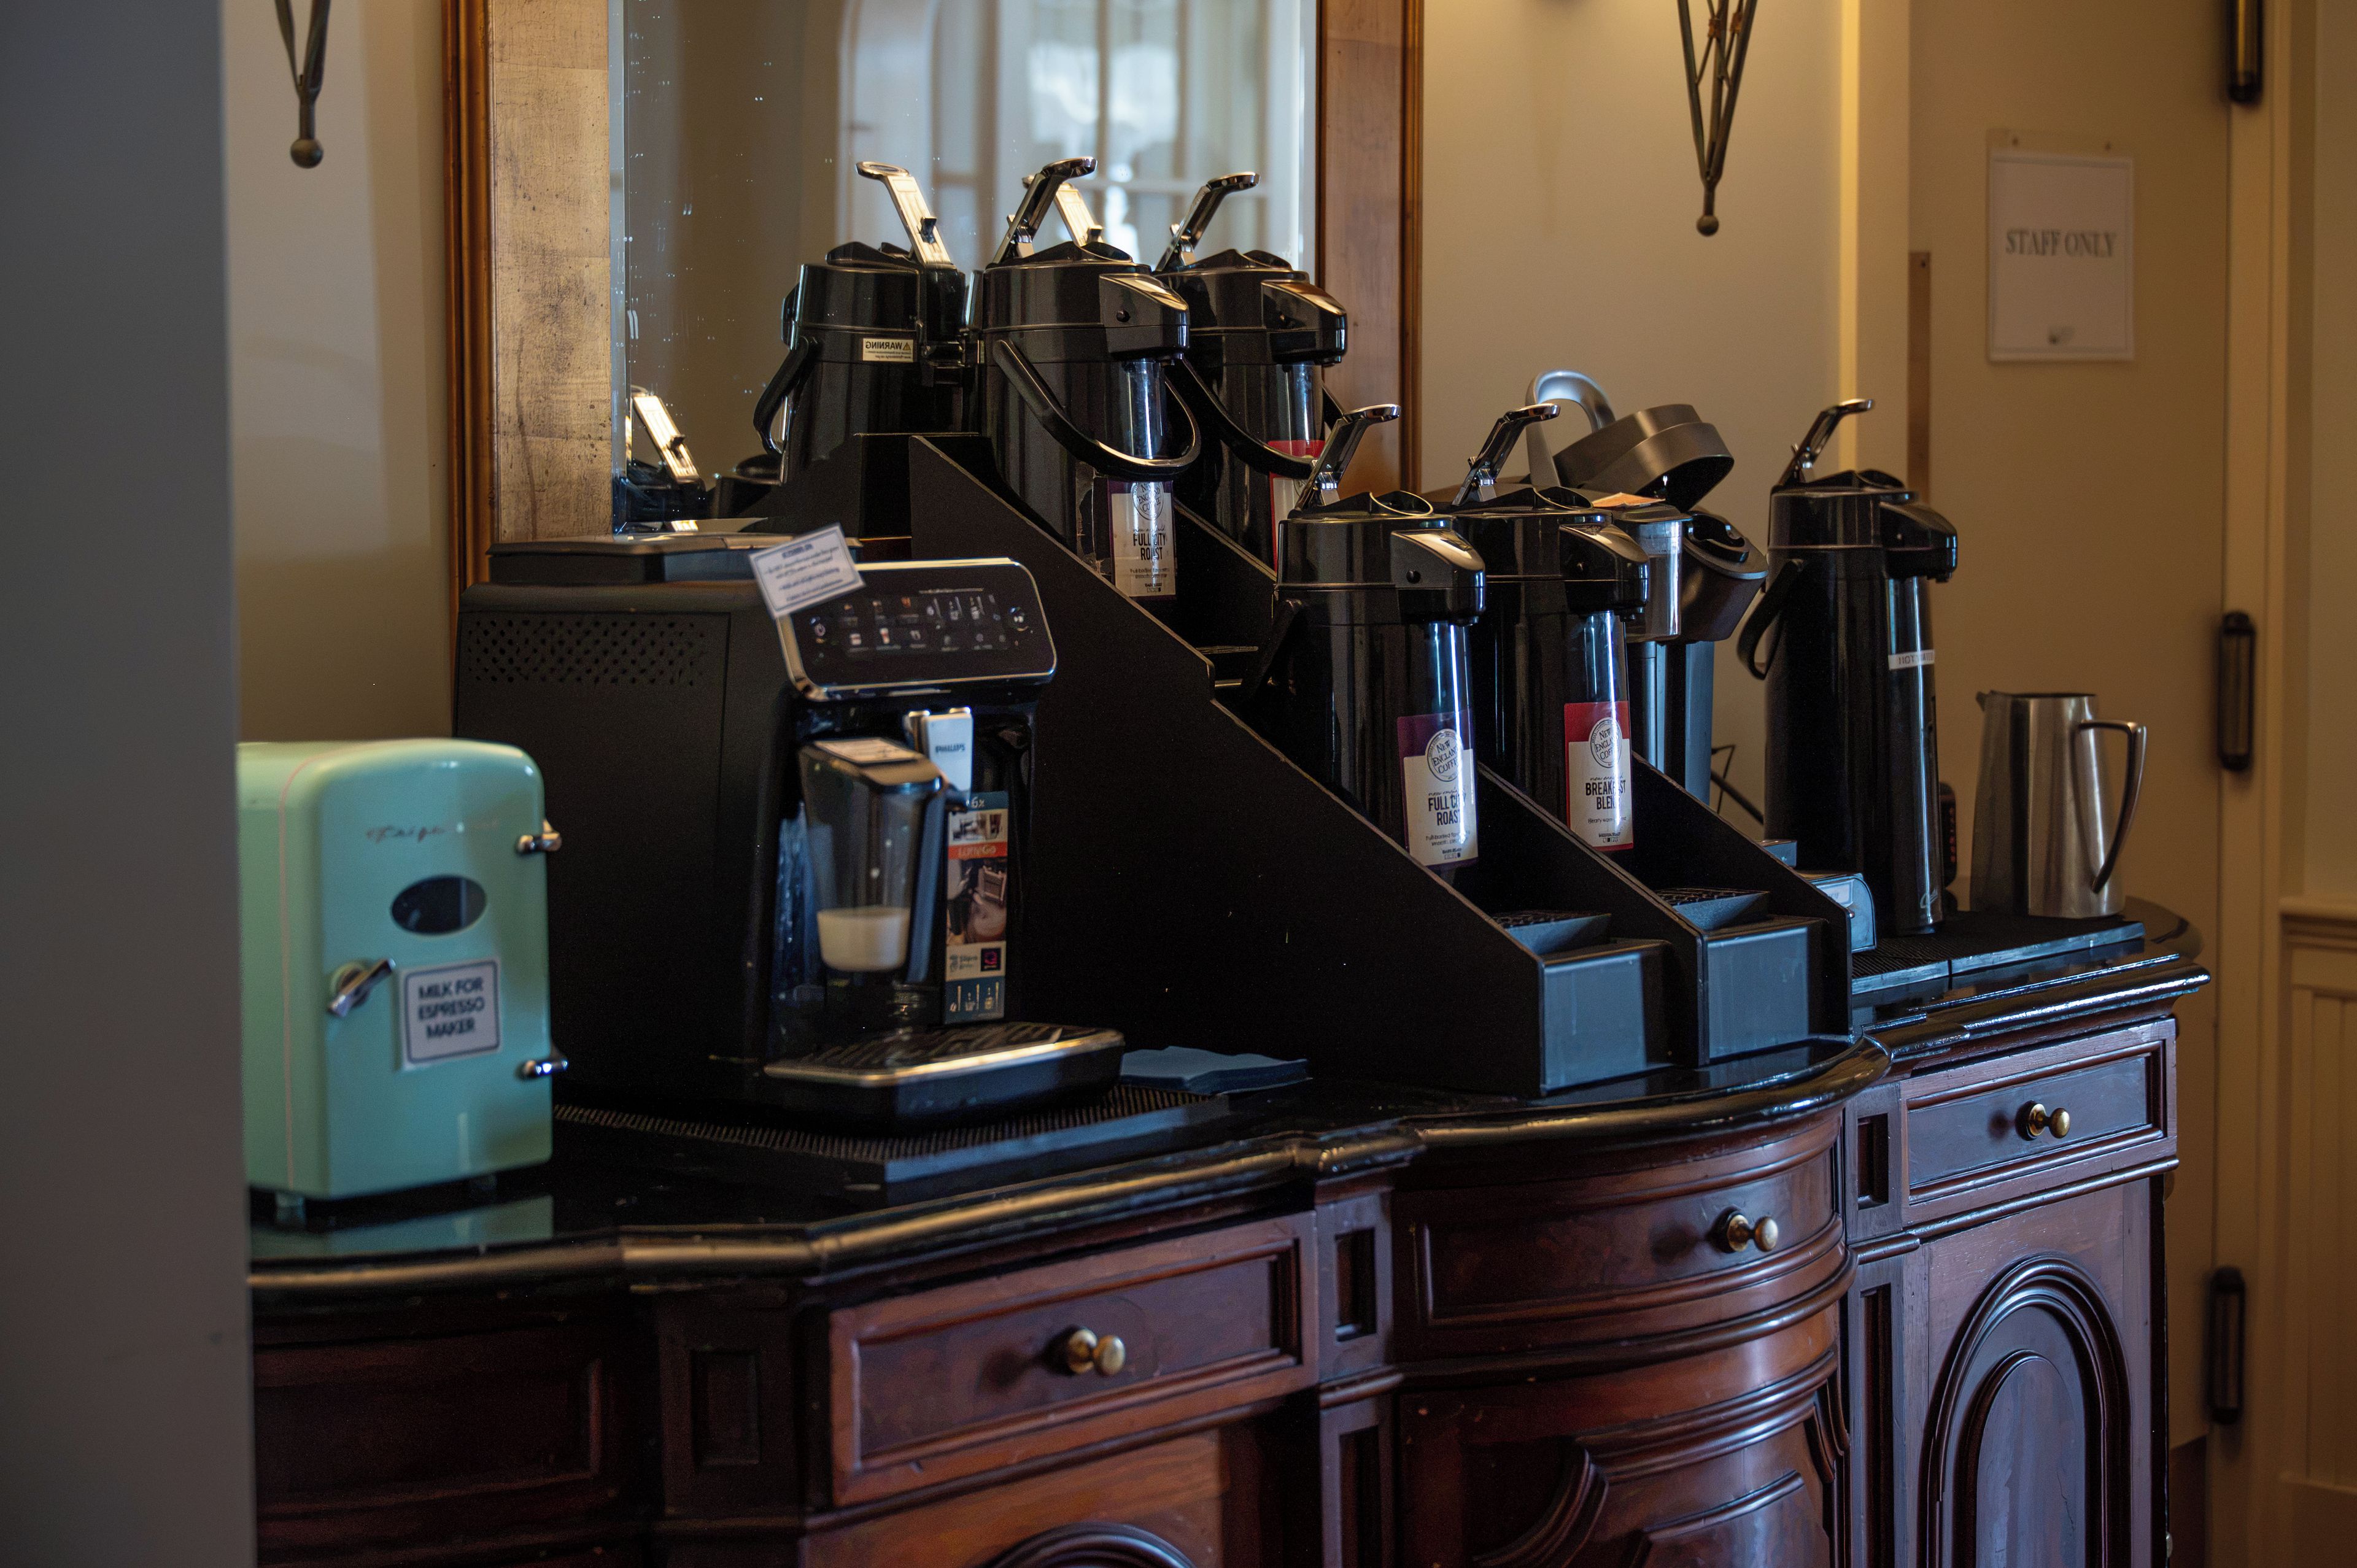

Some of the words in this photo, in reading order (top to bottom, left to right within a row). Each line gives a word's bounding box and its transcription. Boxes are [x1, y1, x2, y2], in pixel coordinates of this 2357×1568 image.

[2005, 228, 2061, 257] STAFF
[2064, 229, 2117, 258] ONLY
[1133, 533, 1152, 546] FULL
[1599, 728, 1611, 740] NEW
[1436, 740, 1450, 754] NEW
[1431, 745, 1458, 767] ENGLAN
[1585, 780, 1626, 796] BREAKFST
[1428, 795, 1450, 811] FULL
[1596, 795, 1617, 809] BLEN
[1437, 809, 1461, 826] ROAS
[418, 983, 454, 1000] MILK
[455, 976, 484, 995] FOR
[417, 995, 485, 1021] ESPRESSO
[426, 1019, 476, 1040] MAKER
